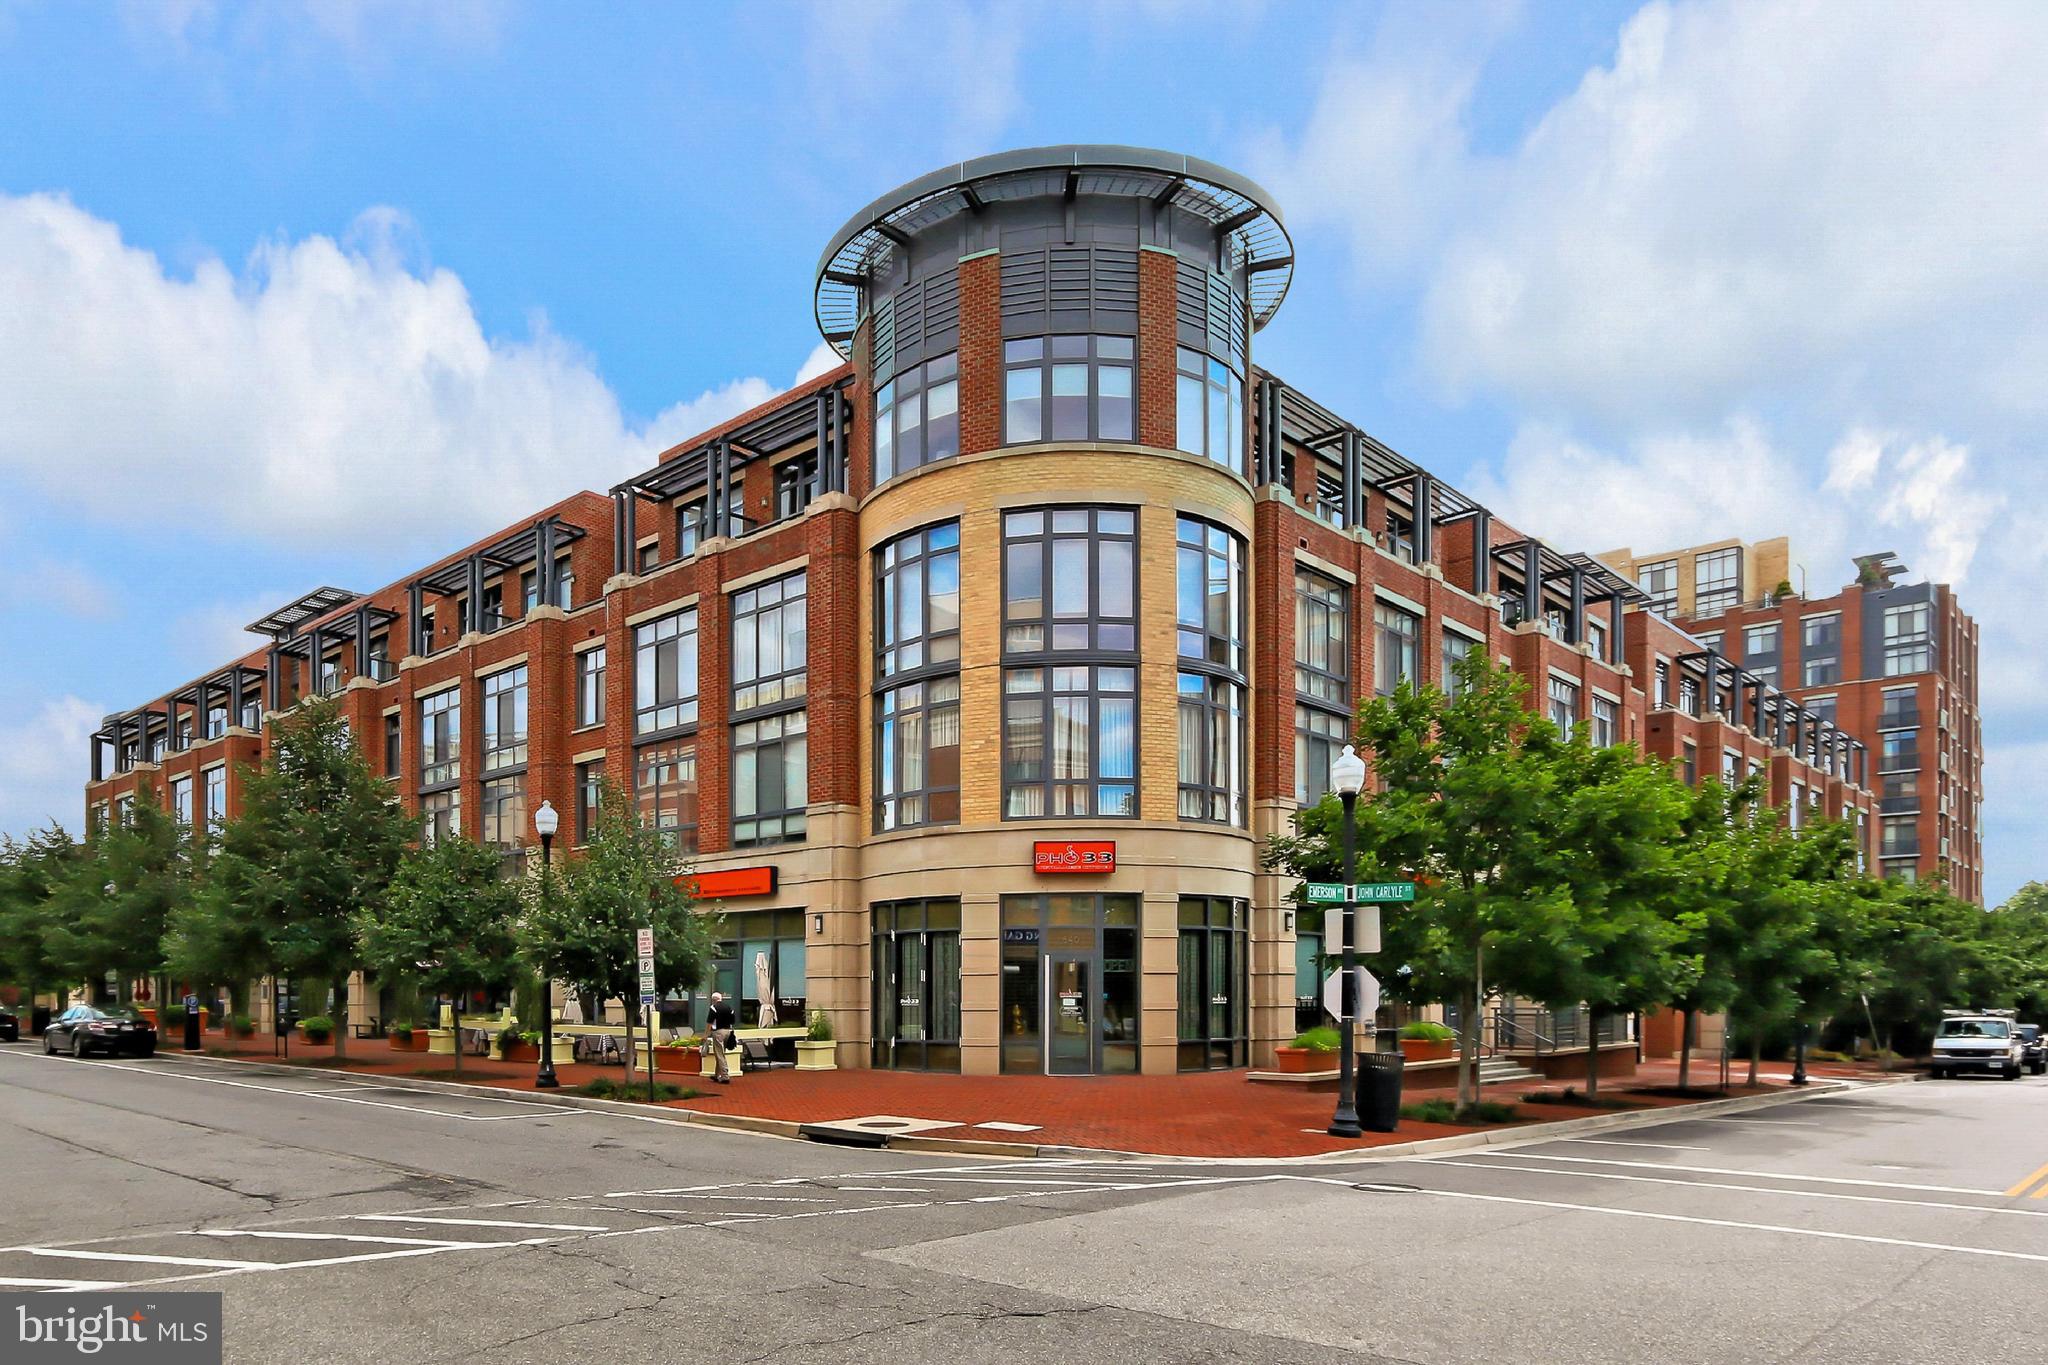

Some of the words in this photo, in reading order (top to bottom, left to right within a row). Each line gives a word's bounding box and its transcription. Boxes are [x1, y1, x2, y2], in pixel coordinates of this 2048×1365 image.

[1082, 852, 1113, 863] 33
[1308, 886, 1337, 898] EMERSON
[1358, 887, 1374, 899] JOHN
[1375, 885, 1403, 898] CARLYLE
